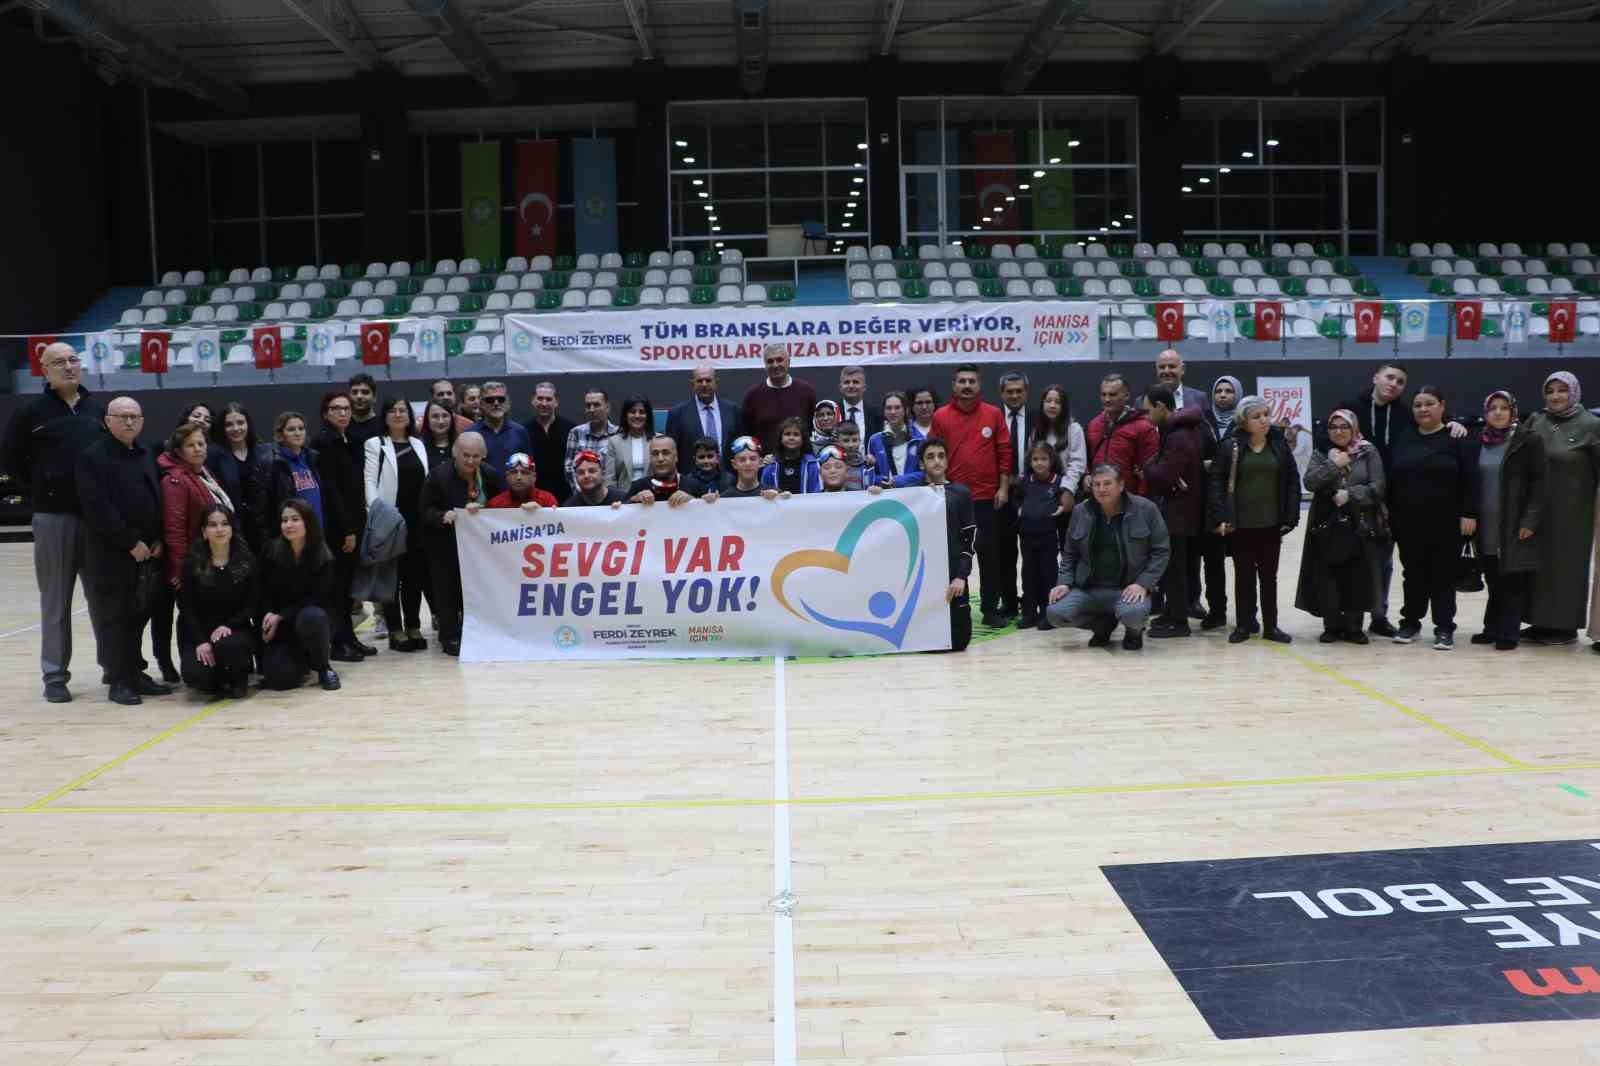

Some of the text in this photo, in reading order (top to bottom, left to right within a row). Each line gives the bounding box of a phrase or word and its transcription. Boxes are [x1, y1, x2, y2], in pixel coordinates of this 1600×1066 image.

[581, 334, 632, 345] ZEYREK
[640, 314, 1021, 340] TÜM BRANŞLARA DEĞER VERİYOR,
[640, 336, 1022, 361] SPORCULARIZA DESTEK OLUYORUZ.
[1263, 387, 1303, 401] Engel
[522, 529, 745, 578] SEVGİ VAR
[517, 575, 761, 617] ENGEL YOK!
[630, 628, 677, 638] ZEYREK
[1462, 910, 1600, 949] YE
